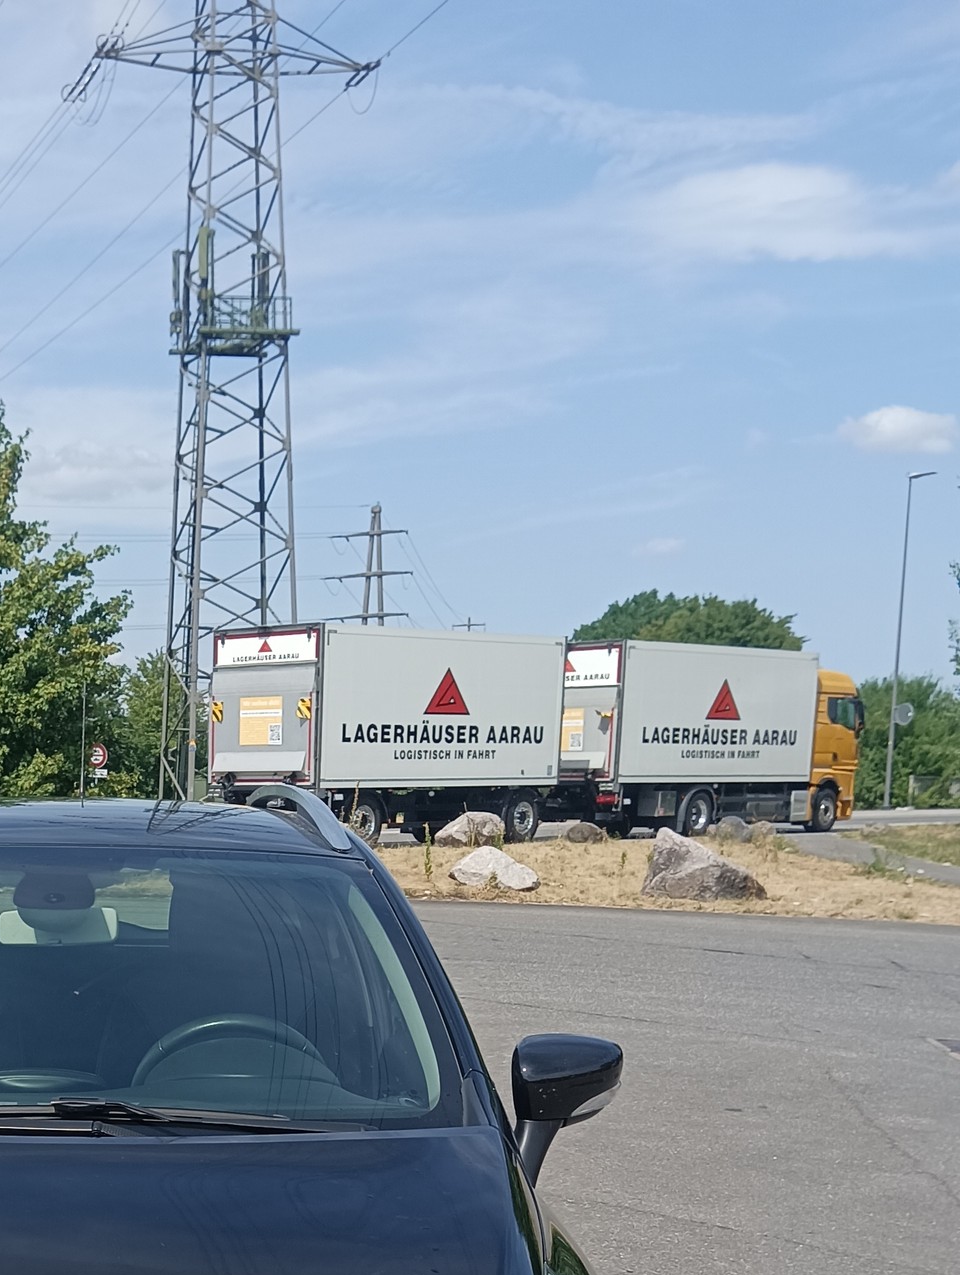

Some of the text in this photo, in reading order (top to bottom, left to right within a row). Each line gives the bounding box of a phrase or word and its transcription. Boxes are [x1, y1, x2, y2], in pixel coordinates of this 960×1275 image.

[341, 720, 544, 744] LAGERHÄUSER AARAU
[642, 724, 798, 746] LAGERHÄUSER AARAU
[393, 750, 497, 760] LOGISTISCH IN FAHRT
[680, 750, 760, 759] LOGISTISCH IN FAHRT
